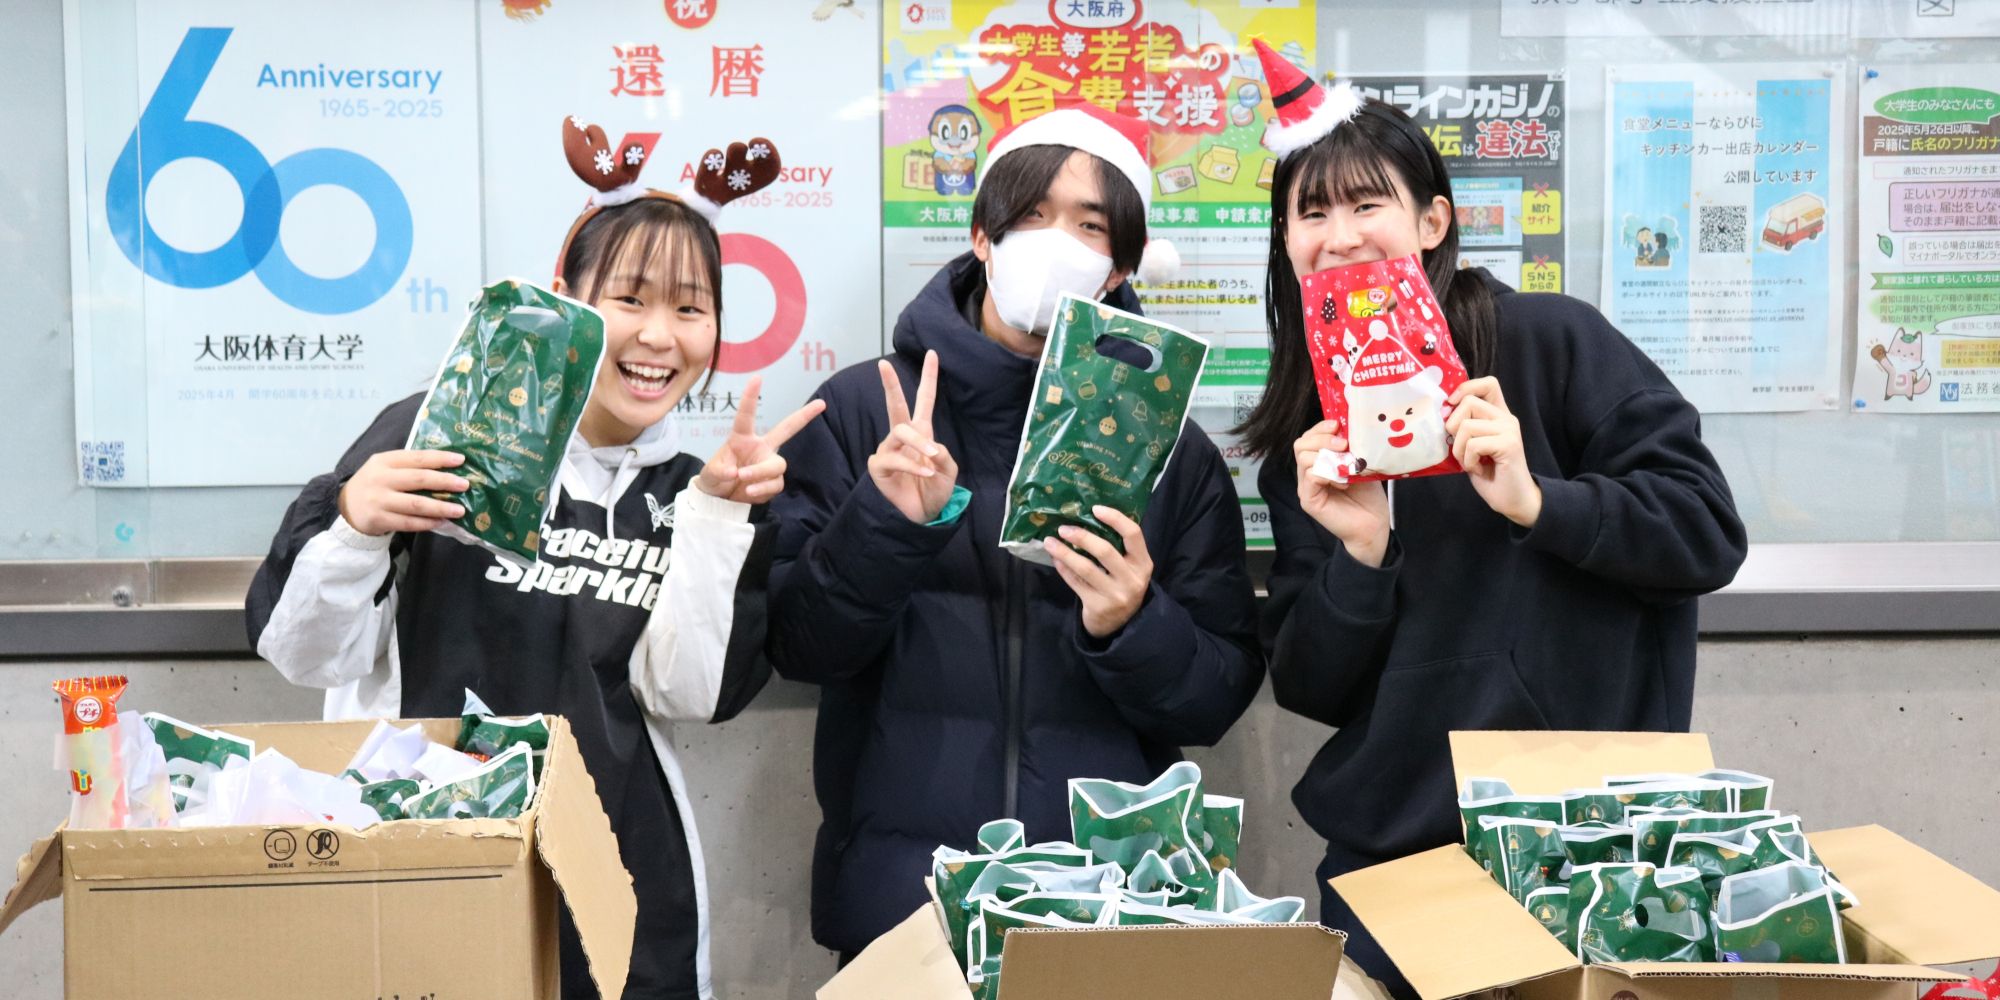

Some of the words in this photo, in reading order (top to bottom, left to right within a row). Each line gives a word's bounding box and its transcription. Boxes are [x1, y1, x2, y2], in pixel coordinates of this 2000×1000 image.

[1067, 0, 1126, 18] 大阪府
[609, 43, 765, 97] 還暦
[256, 63, 442, 94] Anniversary
[319, 97, 442, 118] 1965-2025
[1351, 85, 1560, 119] ラインカジノの
[1884, 98, 1995, 112] 大学生のみなさんにも
[1624, 117, 1763, 131] 食堂メニューならびに
[1641, 141, 1818, 157] キッチンカー出店カレンダー
[1873, 136, 2000, 152] 戸籍に氏名のフリガナ
[105, 27, 414, 315] 60
[1724, 170, 1817, 185] 公開しています
[1903, 165, 2000, 175] 通知されたフリガナをま
[920, 206, 974, 222] 大阪府
[1903, 201, 2000, 214] 場合は、届出をしな
[1527, 216, 1555, 225] サイト
[1904, 215, 2000, 227] そのまま戸籍に記載
[1527, 271, 1556, 280] SNS
[405, 277, 448, 313] th
[194, 334, 364, 362] 大阪体育大学
[801, 342, 836, 372] th
[1362, 351, 1402, 366] MERRY
[1353, 362, 1416, 383] CHRISTMAS
